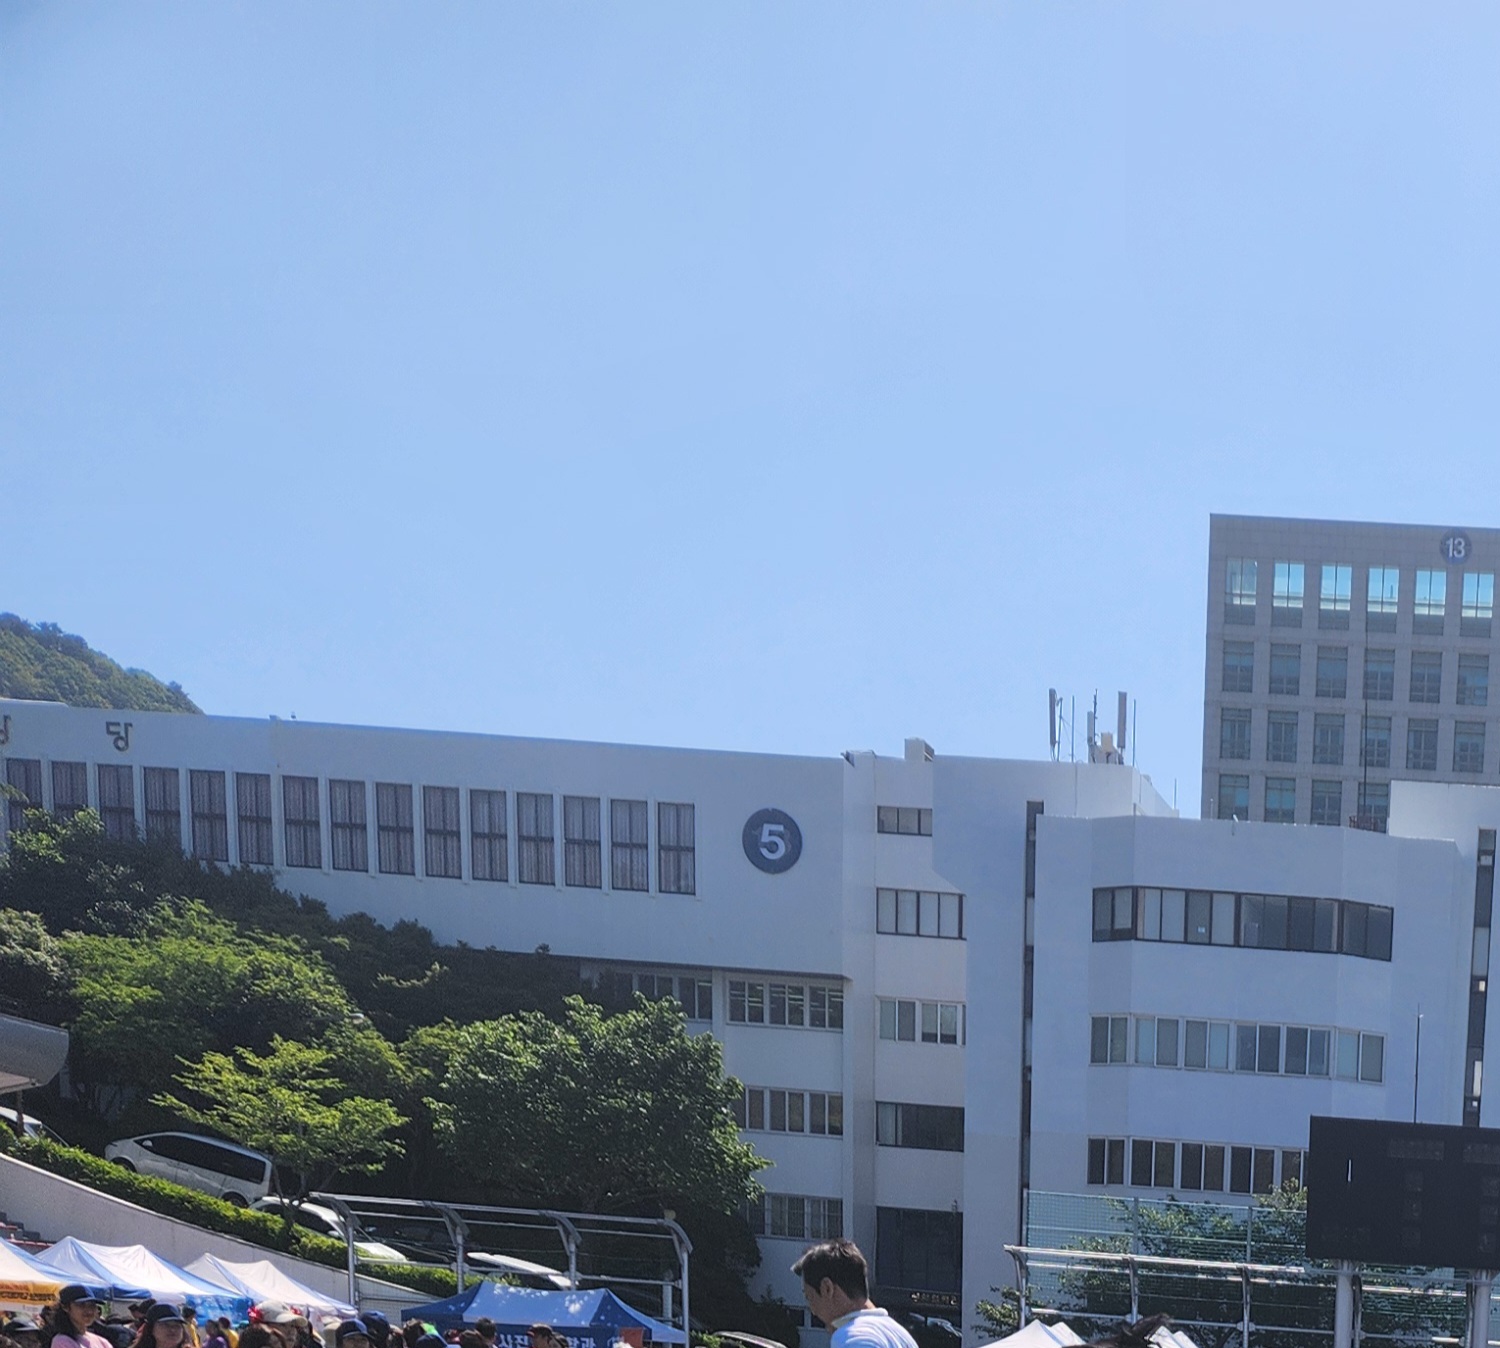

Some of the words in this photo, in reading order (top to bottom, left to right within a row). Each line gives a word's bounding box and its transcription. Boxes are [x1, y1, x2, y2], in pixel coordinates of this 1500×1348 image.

[1446, 537, 1466, 559] 13
[105, 720, 134, 752] 당
[759, 822, 786, 860] 5
